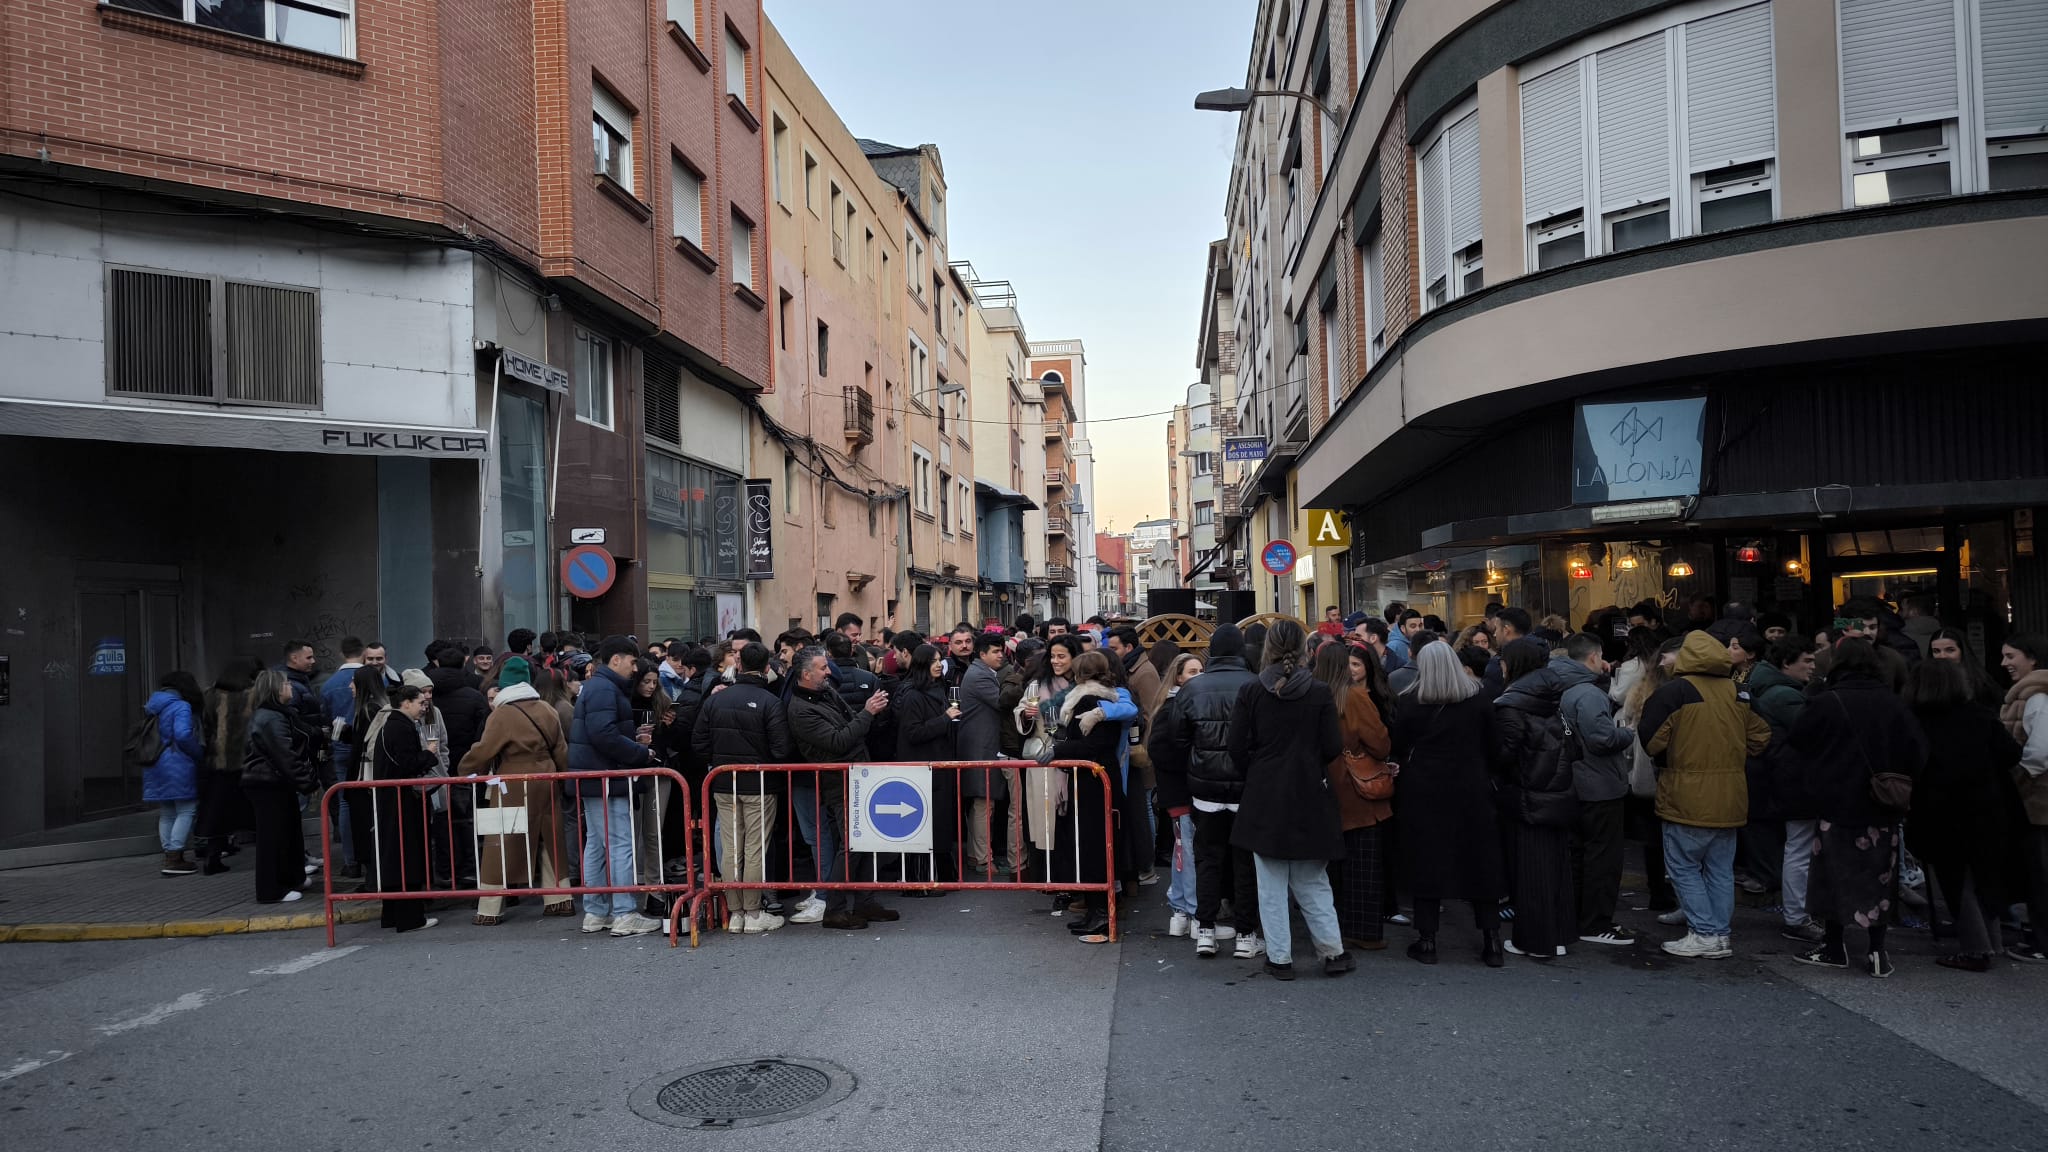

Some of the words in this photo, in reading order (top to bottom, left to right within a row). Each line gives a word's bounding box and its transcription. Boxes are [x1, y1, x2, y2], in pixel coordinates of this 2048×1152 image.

[505, 354, 542, 379] HOME
[543, 368, 568, 389] LIFE
[1577, 465, 1606, 487] LA
[1613, 456, 1695, 484] LONJA
[1316, 511, 1341, 541] A
